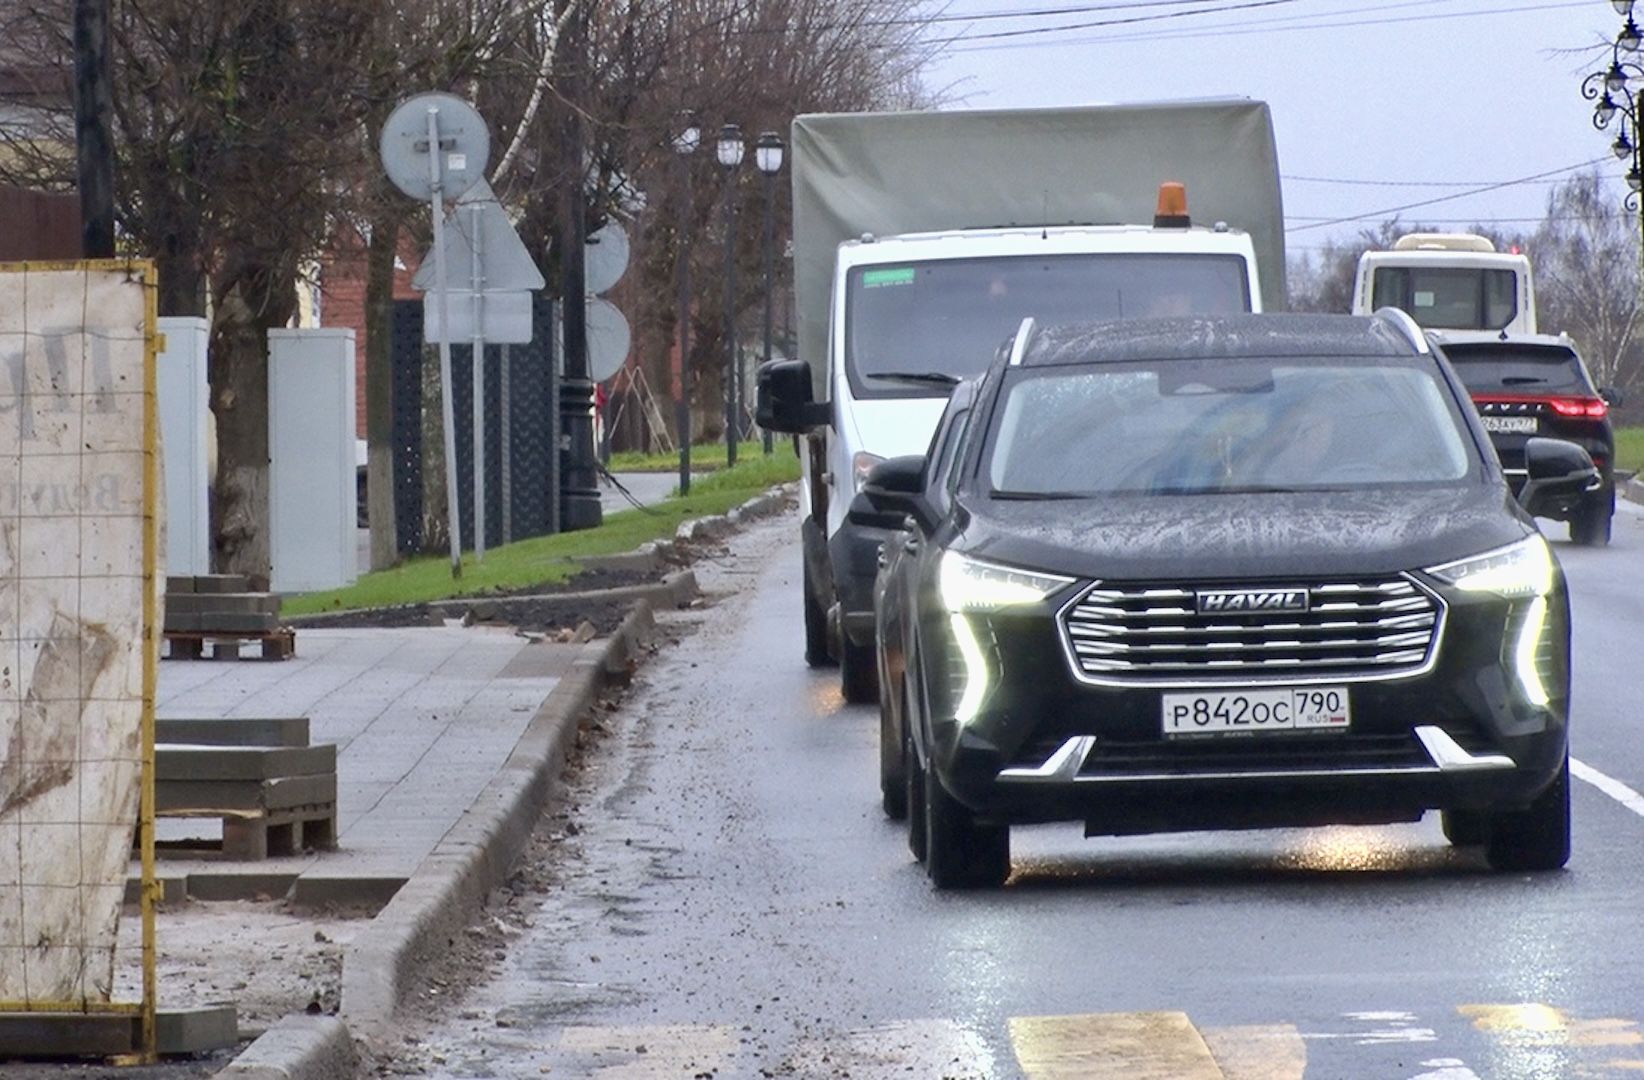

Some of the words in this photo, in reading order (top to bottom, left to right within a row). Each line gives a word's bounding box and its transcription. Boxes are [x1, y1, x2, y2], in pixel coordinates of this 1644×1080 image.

[1204, 593, 1303, 611] HAVAL
[1295, 691, 1340, 714] 790
[1306, 714, 1329, 723] RUS
